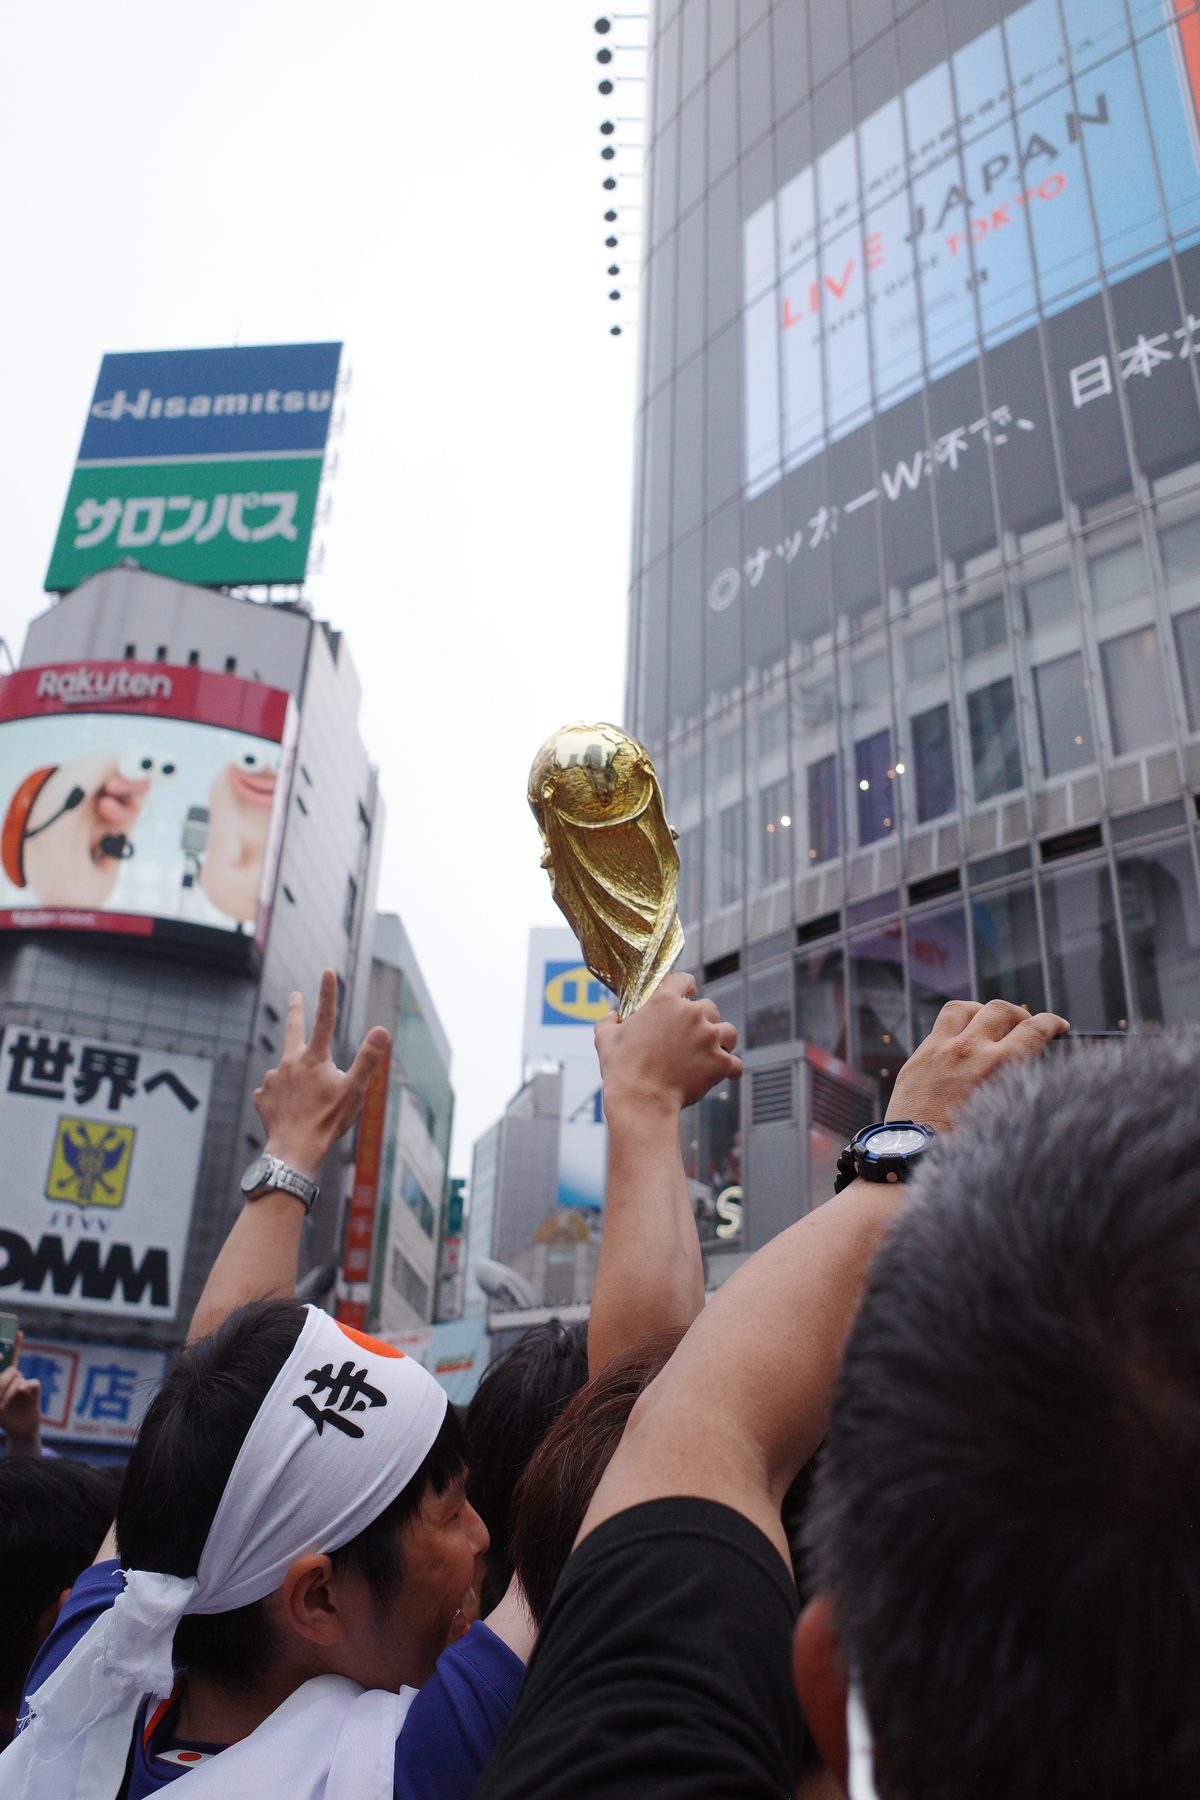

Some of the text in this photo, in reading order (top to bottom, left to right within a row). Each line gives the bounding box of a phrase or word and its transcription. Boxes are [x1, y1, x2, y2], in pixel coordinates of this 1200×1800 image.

[784, 230, 886, 331] LIVE
[904, 92, 1110, 244] JAPAN
[945, 171, 1067, 256] TOKYO
[91, 388, 333, 421] Hisamitsu
[73, 491, 300, 550] サロンパス
[37, 667, 172, 700] Rakuten
[8, 1033, 201, 1113] 世界へ
[292, 1361, 388, 1439] 侍
